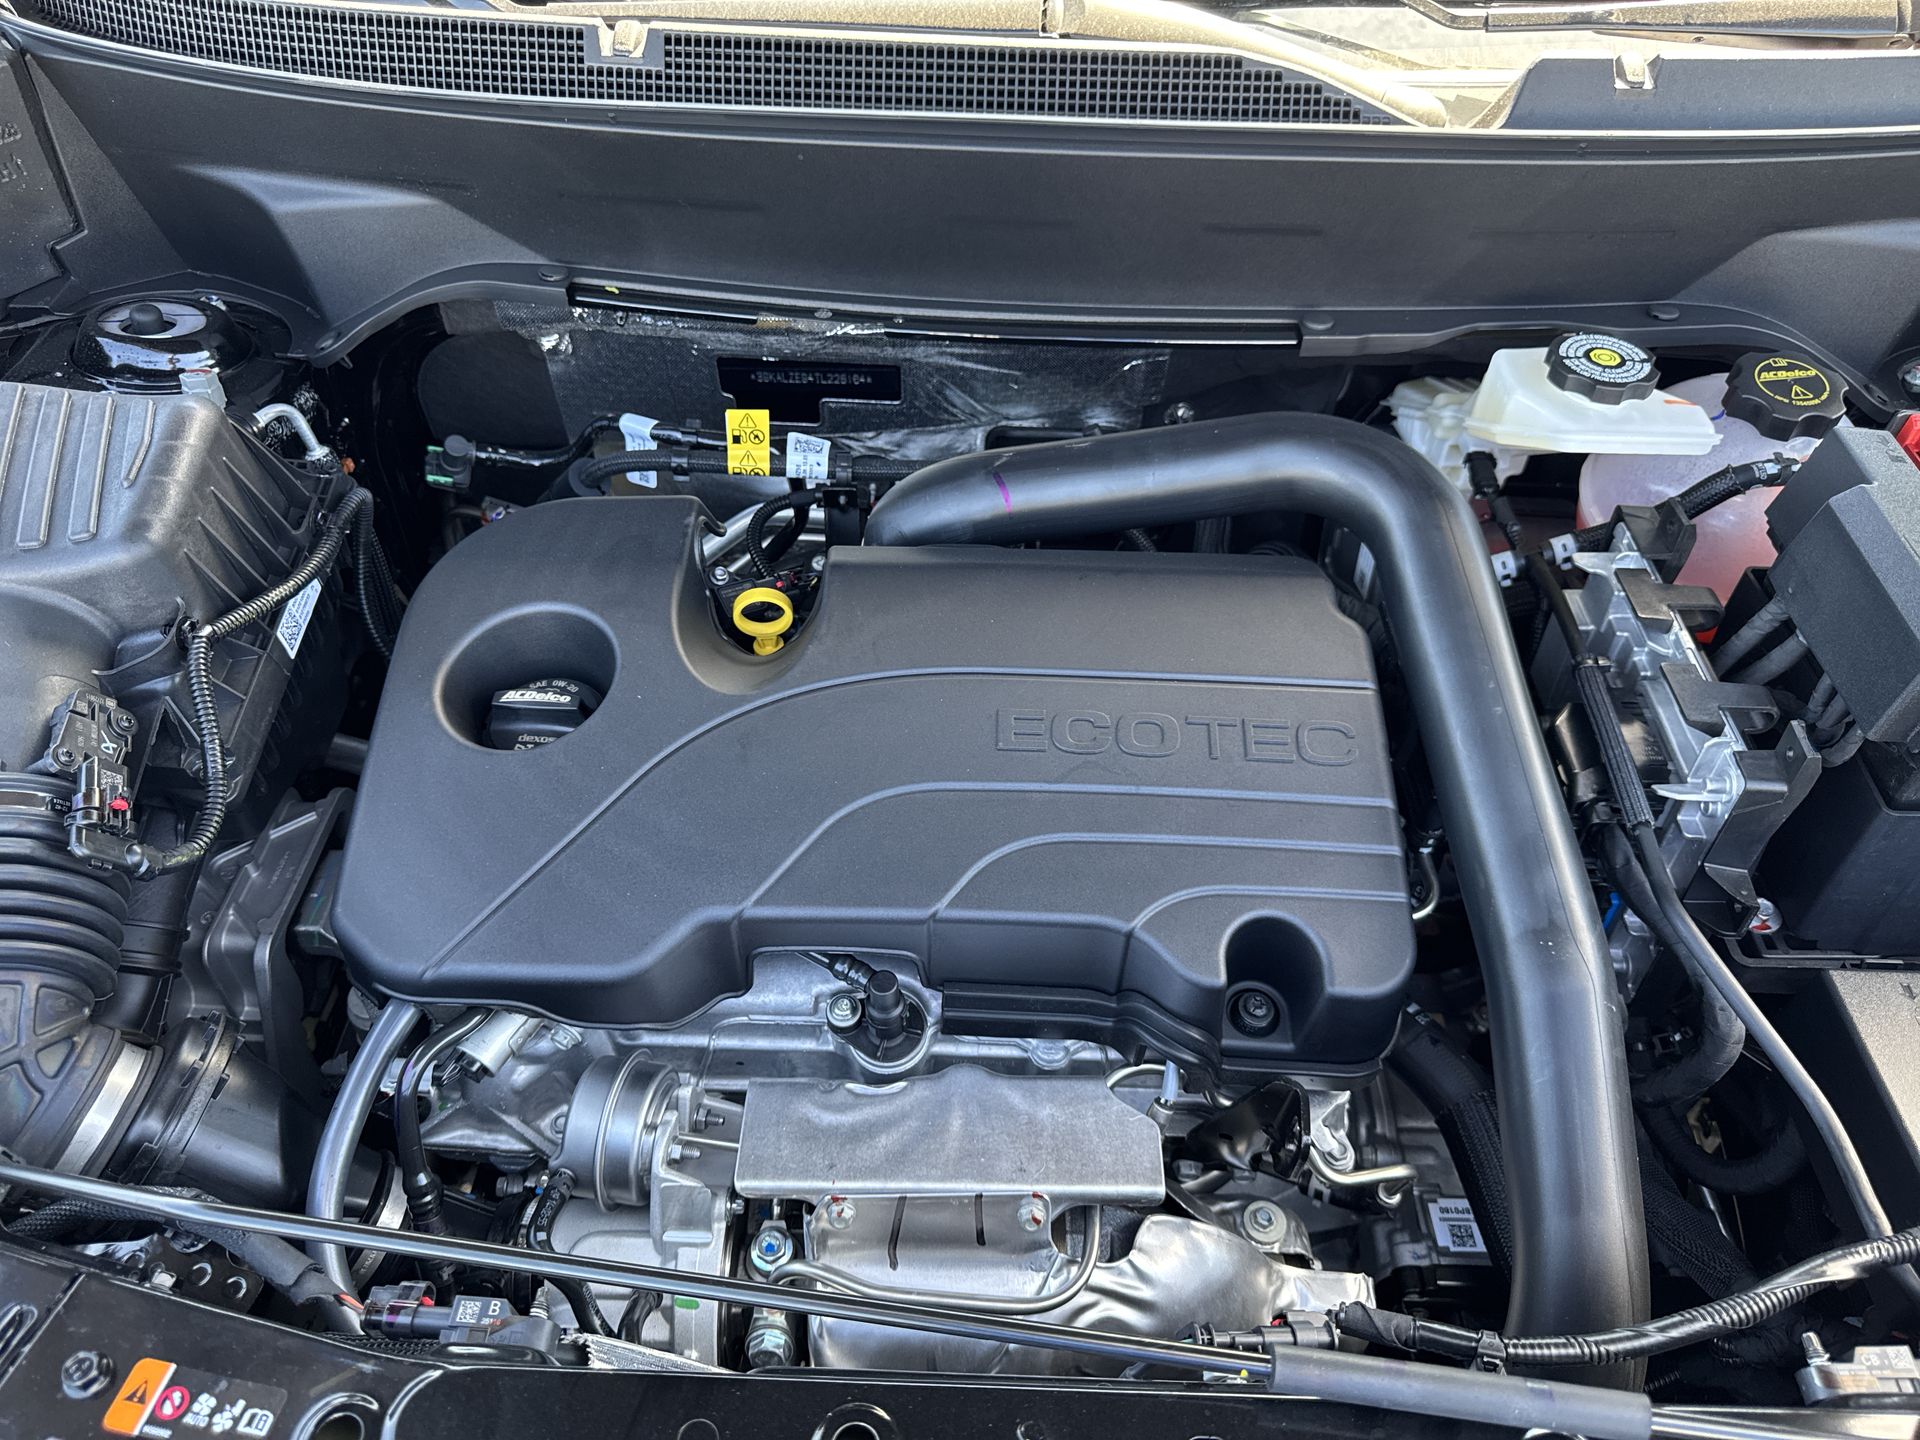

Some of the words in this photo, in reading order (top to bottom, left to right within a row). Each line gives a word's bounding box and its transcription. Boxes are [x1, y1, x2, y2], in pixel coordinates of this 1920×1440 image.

[1760, 369, 1817, 380] ACDelco
[529, 679, 548, 689] SAE
[552, 679, 579, 693] 0W-20
[500, 690, 572, 703] ACDelco
[996, 709, 1360, 767] ECOTEC
[488, 1300, 501, 1316] B
[183, 1413, 210, 1427] AUTO
